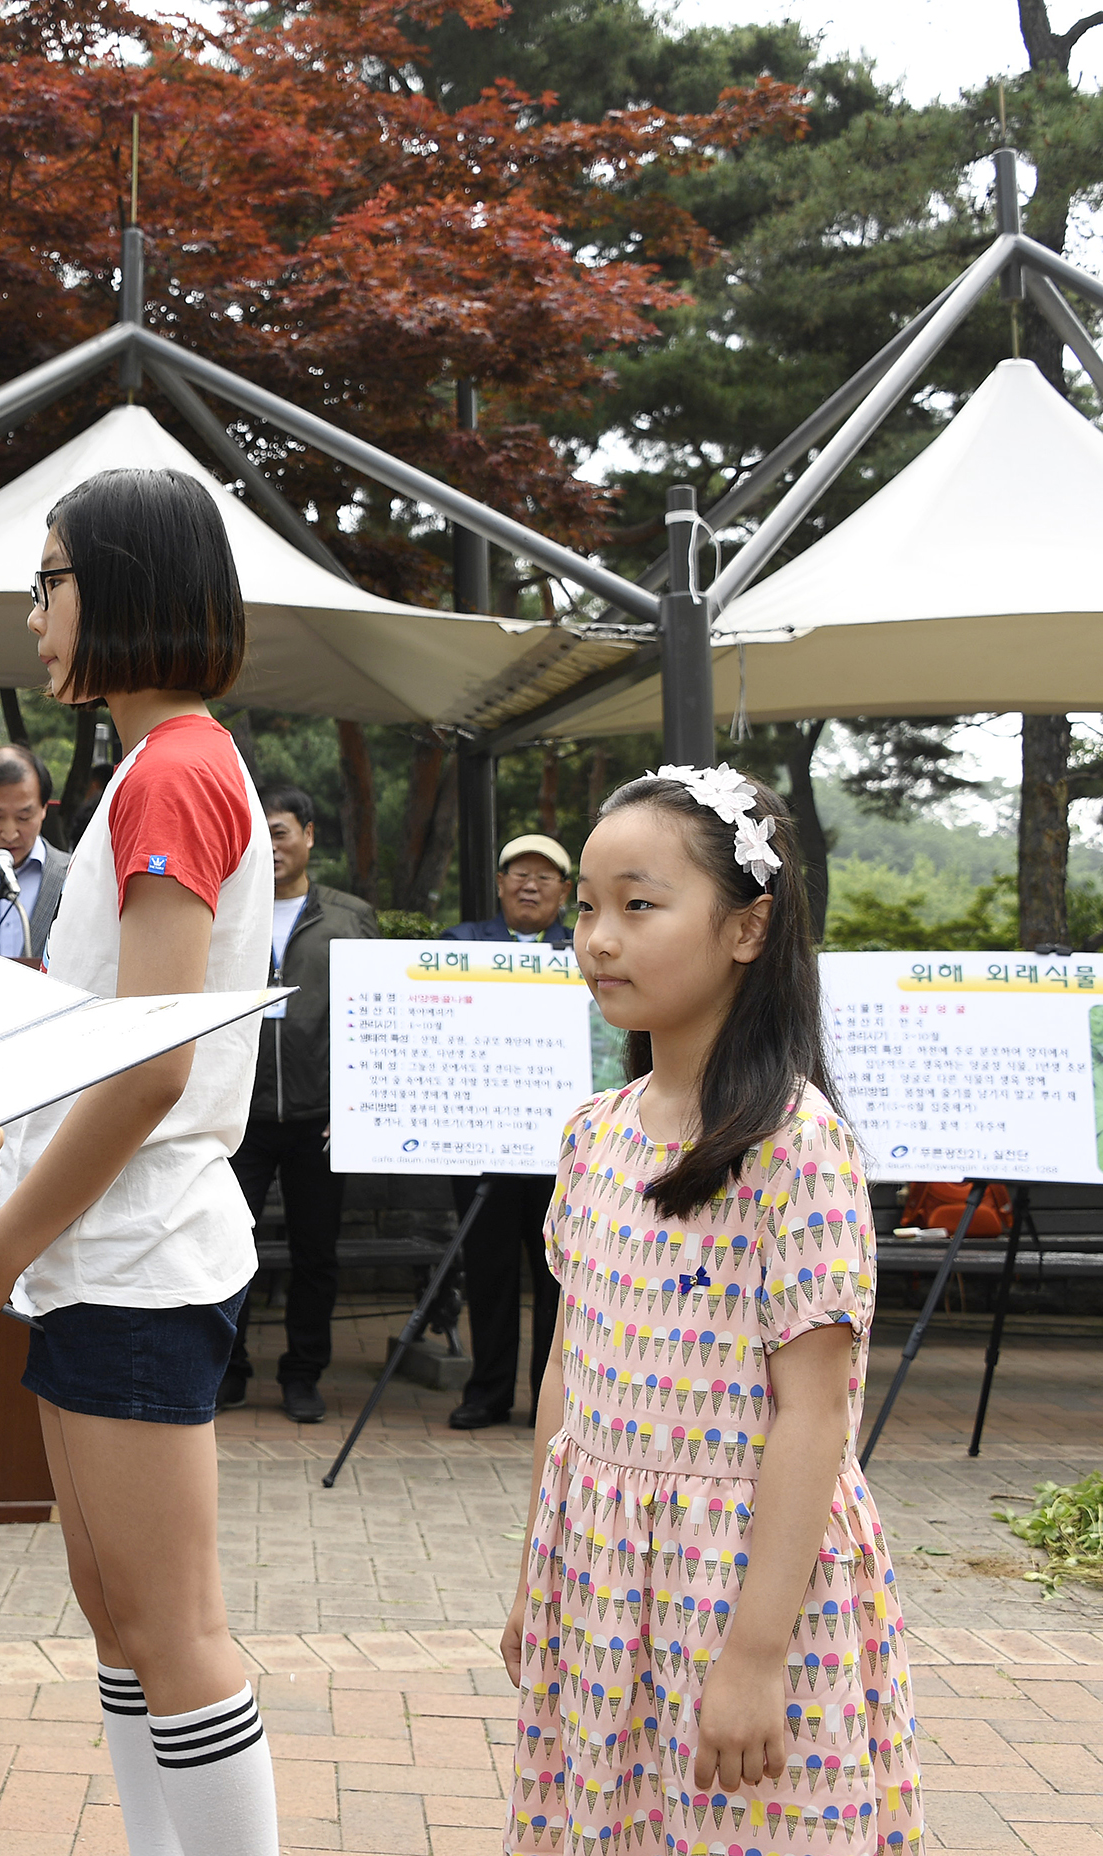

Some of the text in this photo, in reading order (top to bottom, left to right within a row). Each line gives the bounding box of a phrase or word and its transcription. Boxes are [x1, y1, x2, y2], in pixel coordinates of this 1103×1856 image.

[418, 952, 469, 971] 위해
[910, 964, 1096, 989] 위해 외래식물
